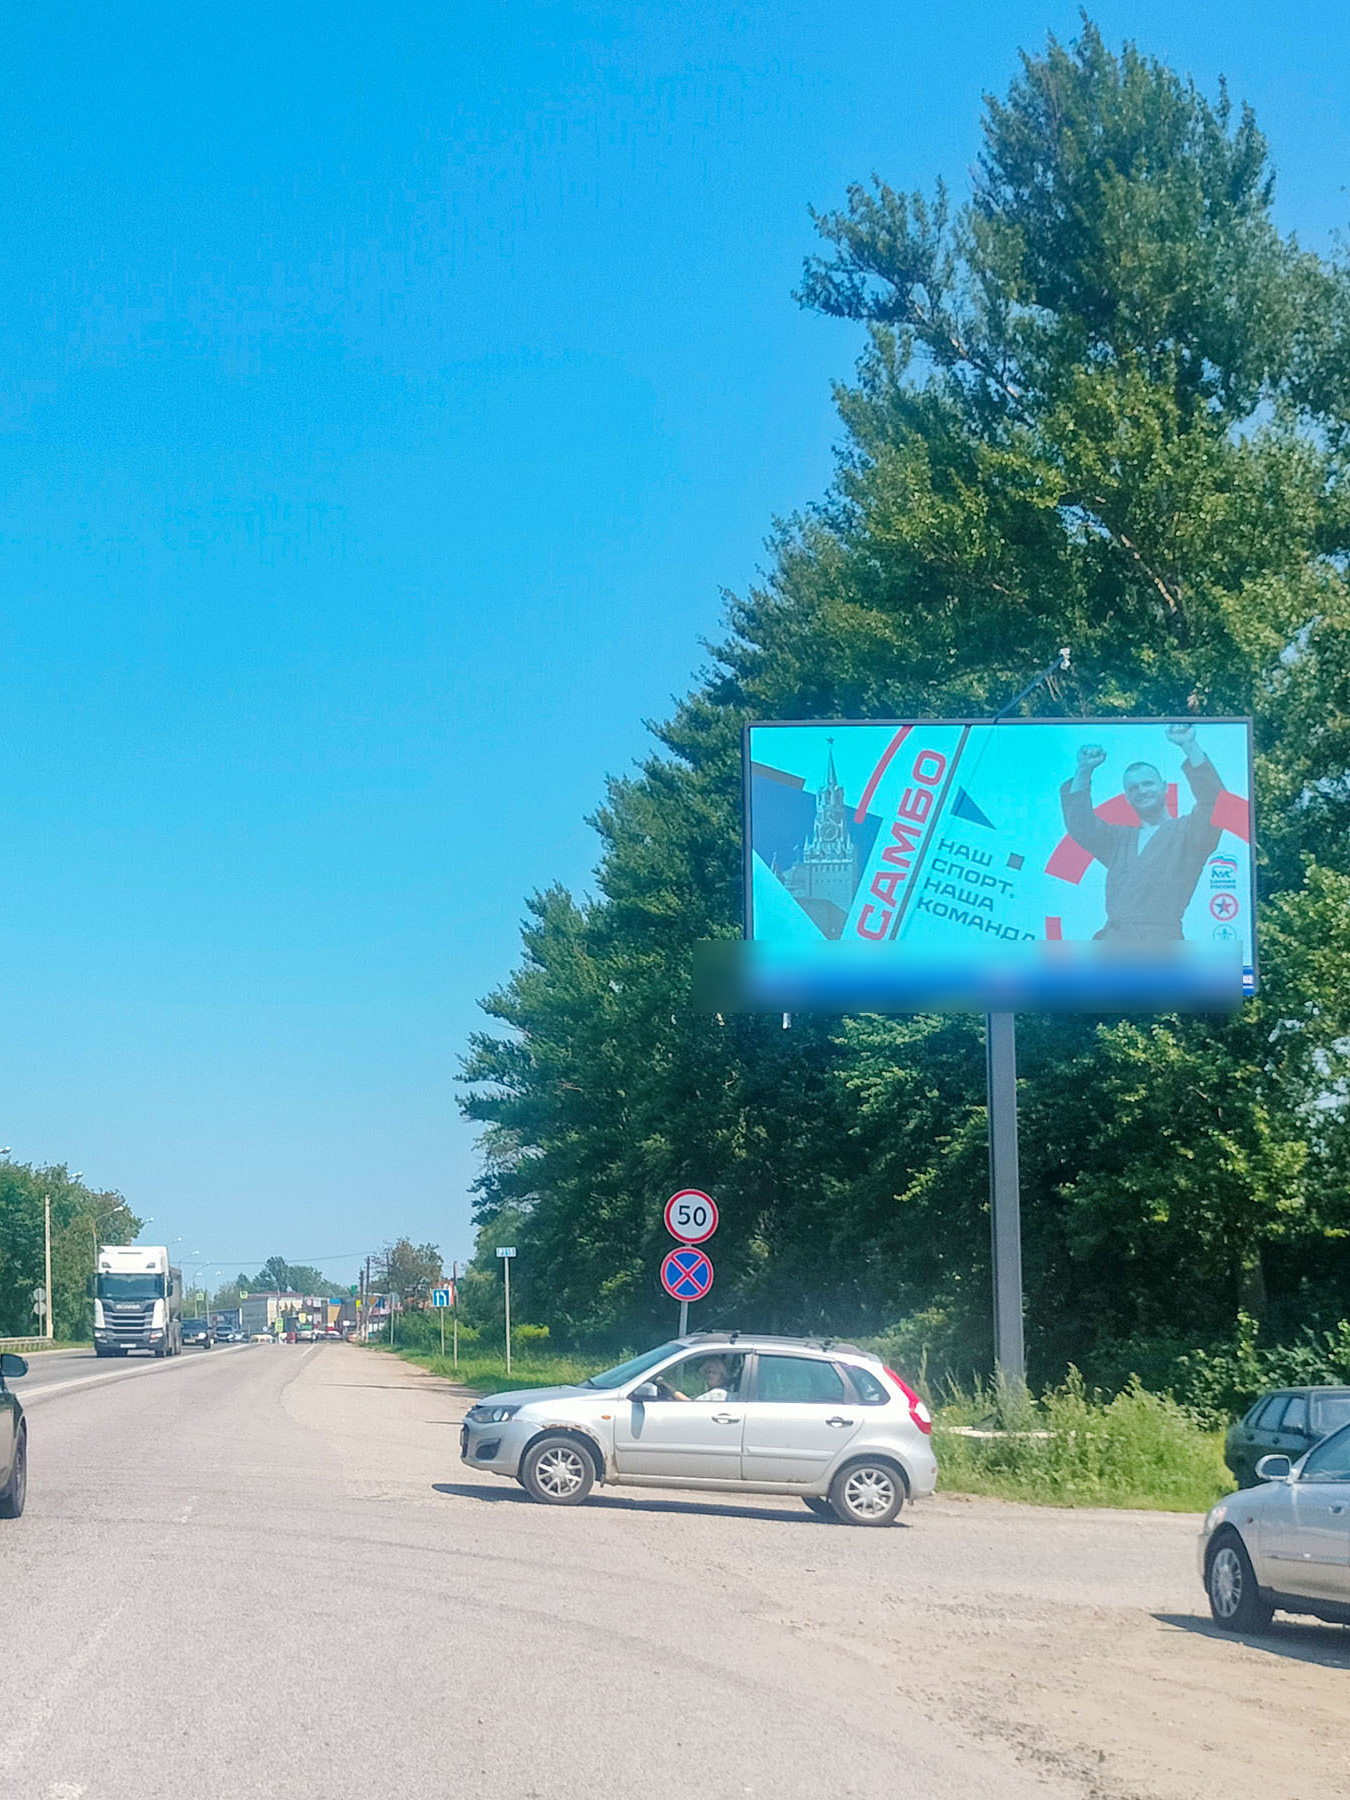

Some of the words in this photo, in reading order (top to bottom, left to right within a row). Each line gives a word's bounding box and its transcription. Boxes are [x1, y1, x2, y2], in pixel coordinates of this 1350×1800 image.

[856, 749, 947, 940] САМБО
[938, 838, 993, 867] НАШ
[923, 877, 994, 912] НАША
[931, 858, 1015, 899] СПОРТ.
[677, 1204, 707, 1227] 50
